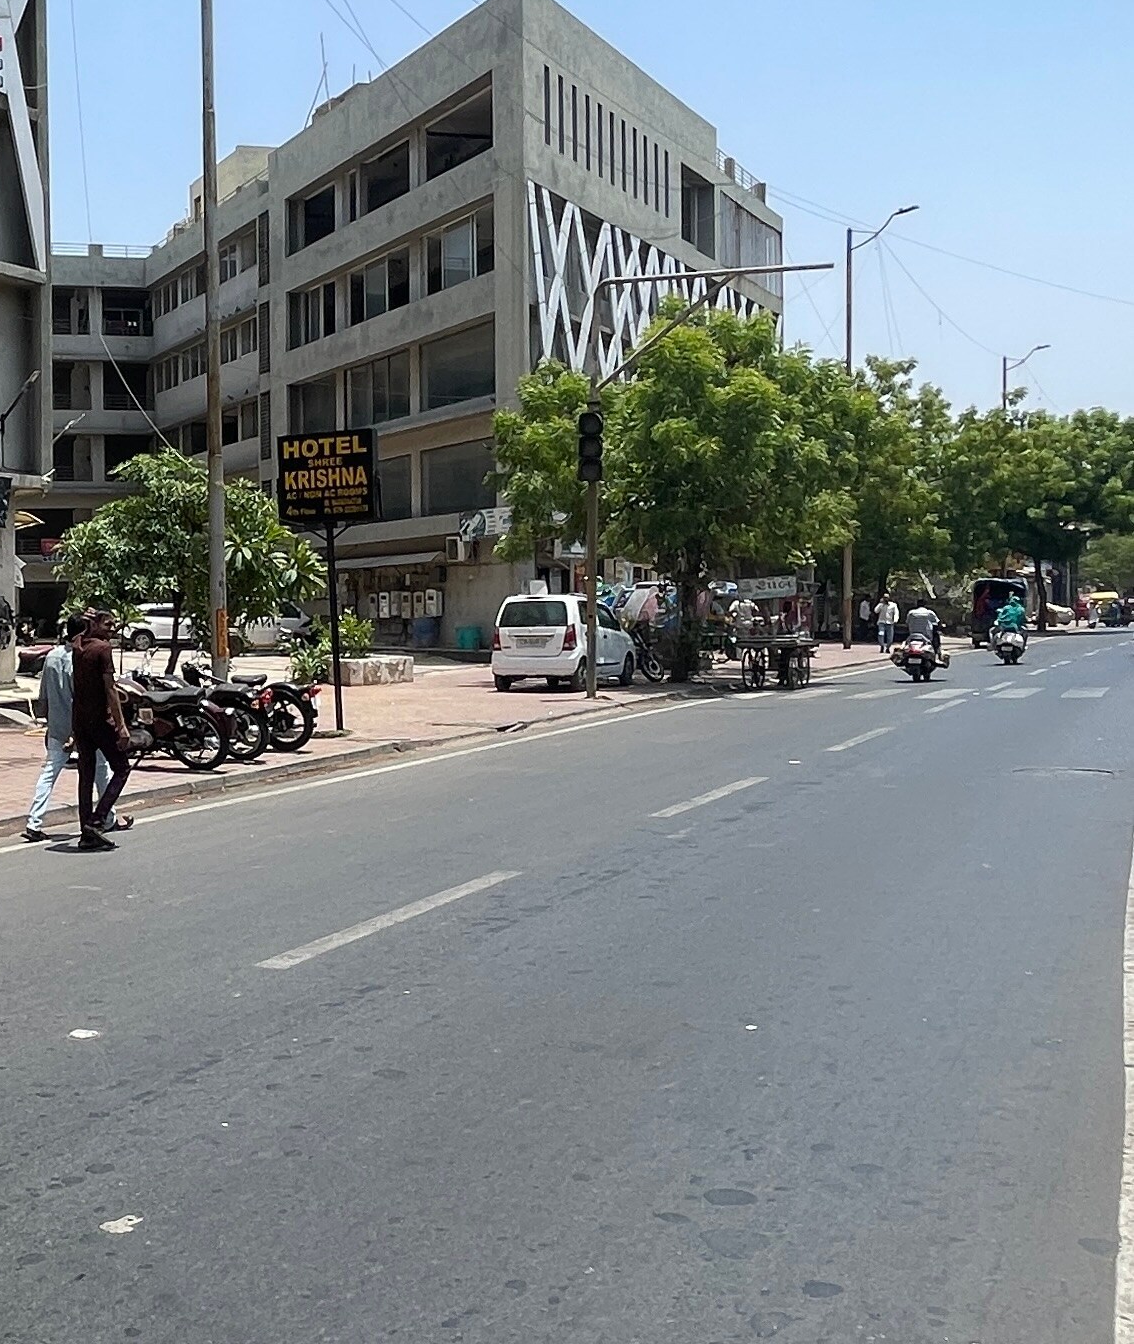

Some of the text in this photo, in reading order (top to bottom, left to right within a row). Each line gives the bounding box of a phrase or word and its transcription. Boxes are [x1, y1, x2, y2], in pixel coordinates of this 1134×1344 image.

[283, 436, 368, 460] HOTEL
[307, 456, 344, 468] SHREE
[284, 465, 368, 491] KRISHNA
